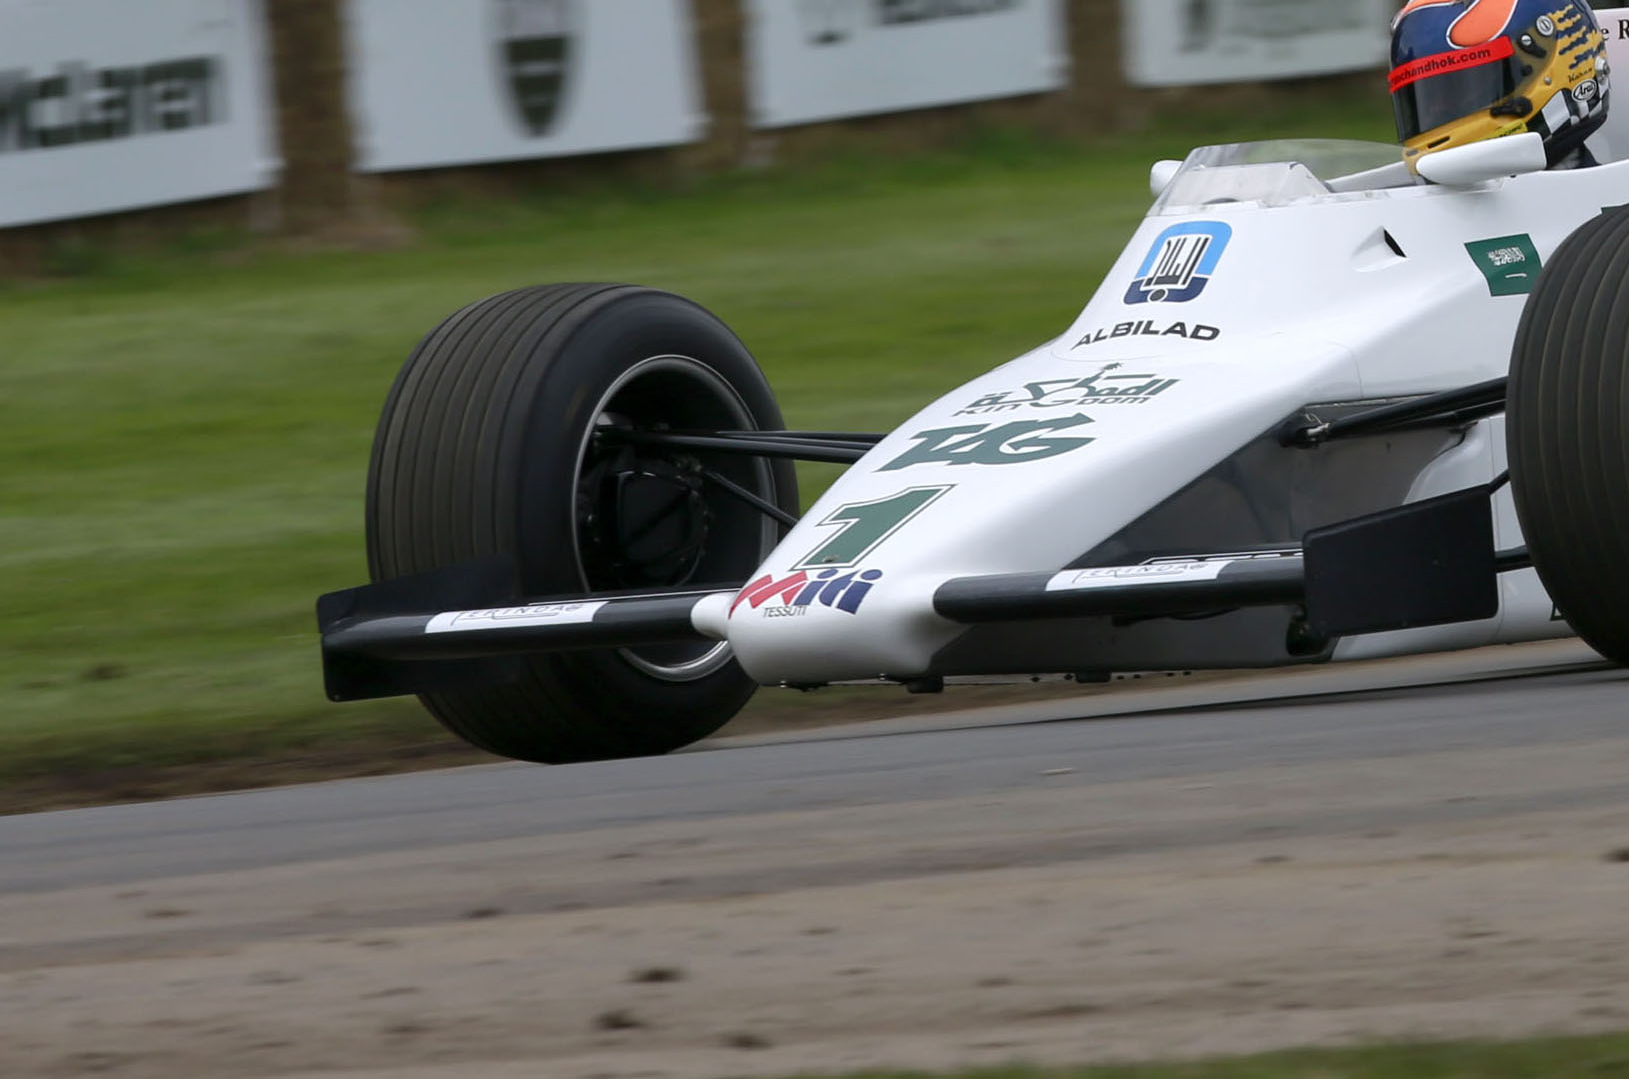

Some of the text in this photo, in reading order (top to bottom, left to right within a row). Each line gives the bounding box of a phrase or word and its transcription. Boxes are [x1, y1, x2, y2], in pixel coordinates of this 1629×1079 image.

[1071, 320, 1221, 351] ALBILAD
[873, 412, 1097, 473] TAG
[789, 483, 959, 572] 1
[763, 607, 807, 618] TESSUTI
